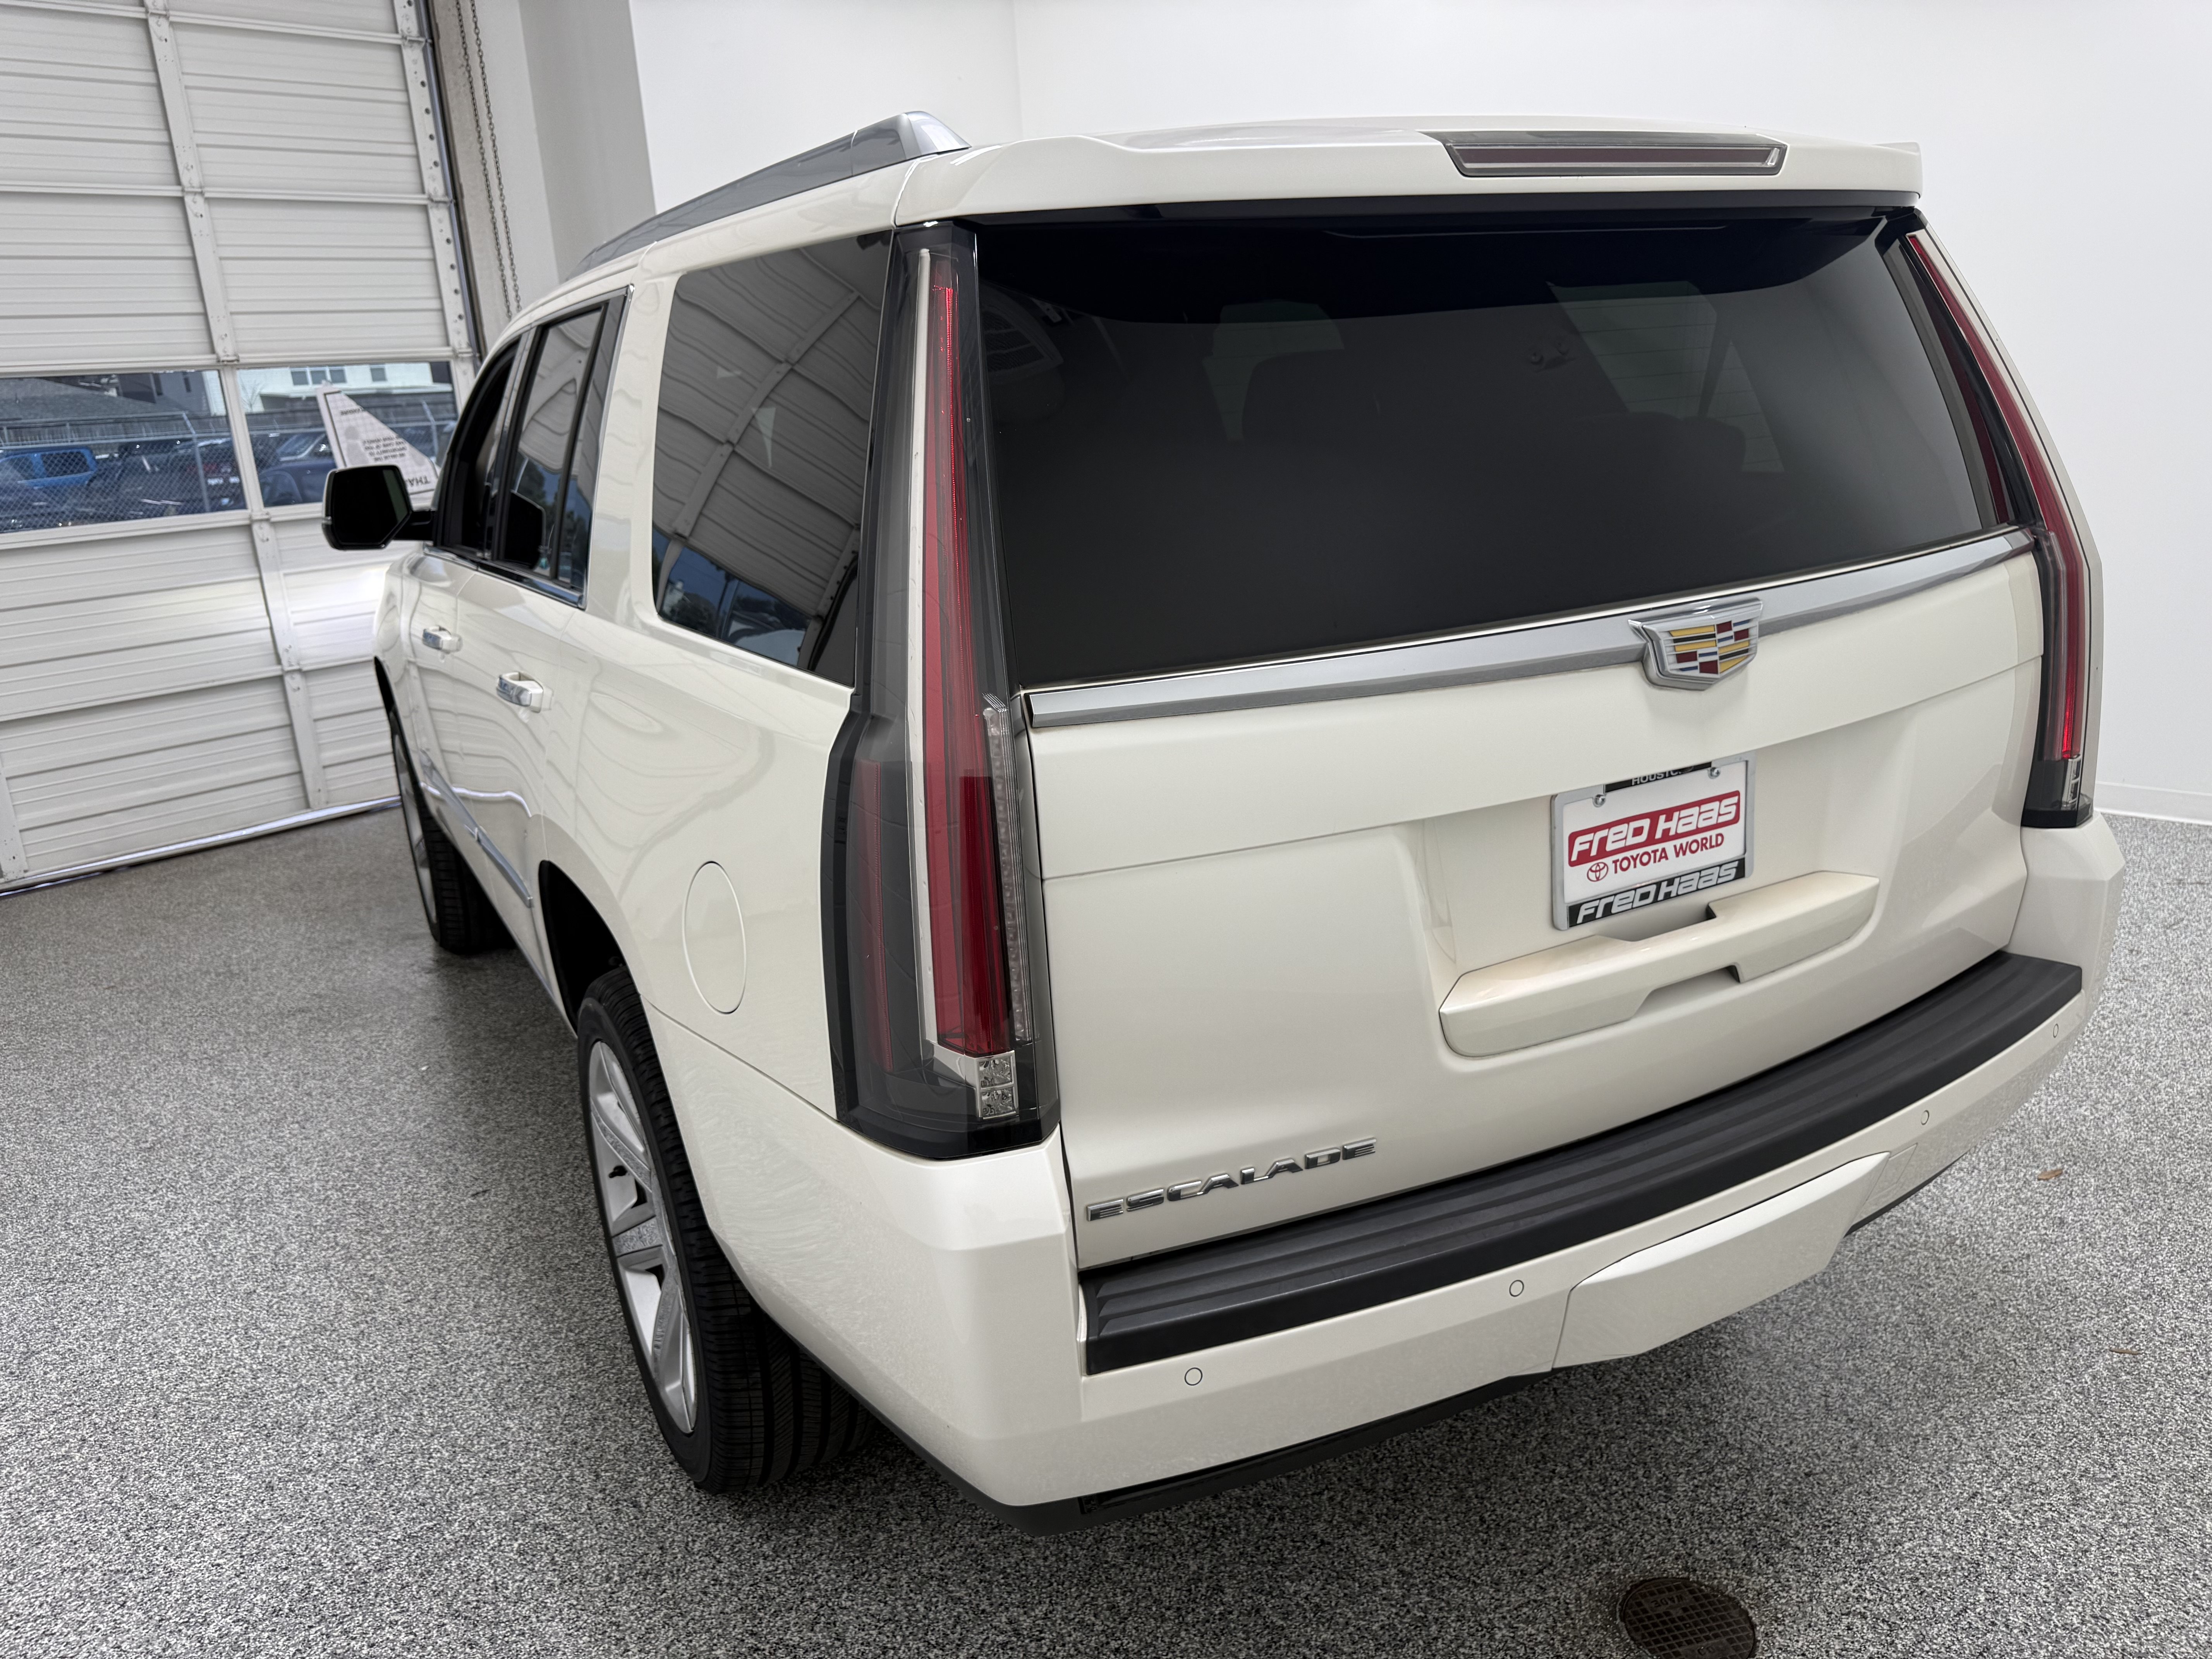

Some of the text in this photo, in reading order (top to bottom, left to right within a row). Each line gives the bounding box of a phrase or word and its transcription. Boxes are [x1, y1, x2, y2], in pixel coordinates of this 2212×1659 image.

[405, 475, 431, 487] THA
[1612, 833, 1724, 874] TOYOTA WORLD
[1086, 1137, 1377, 1221] ESCALADE
